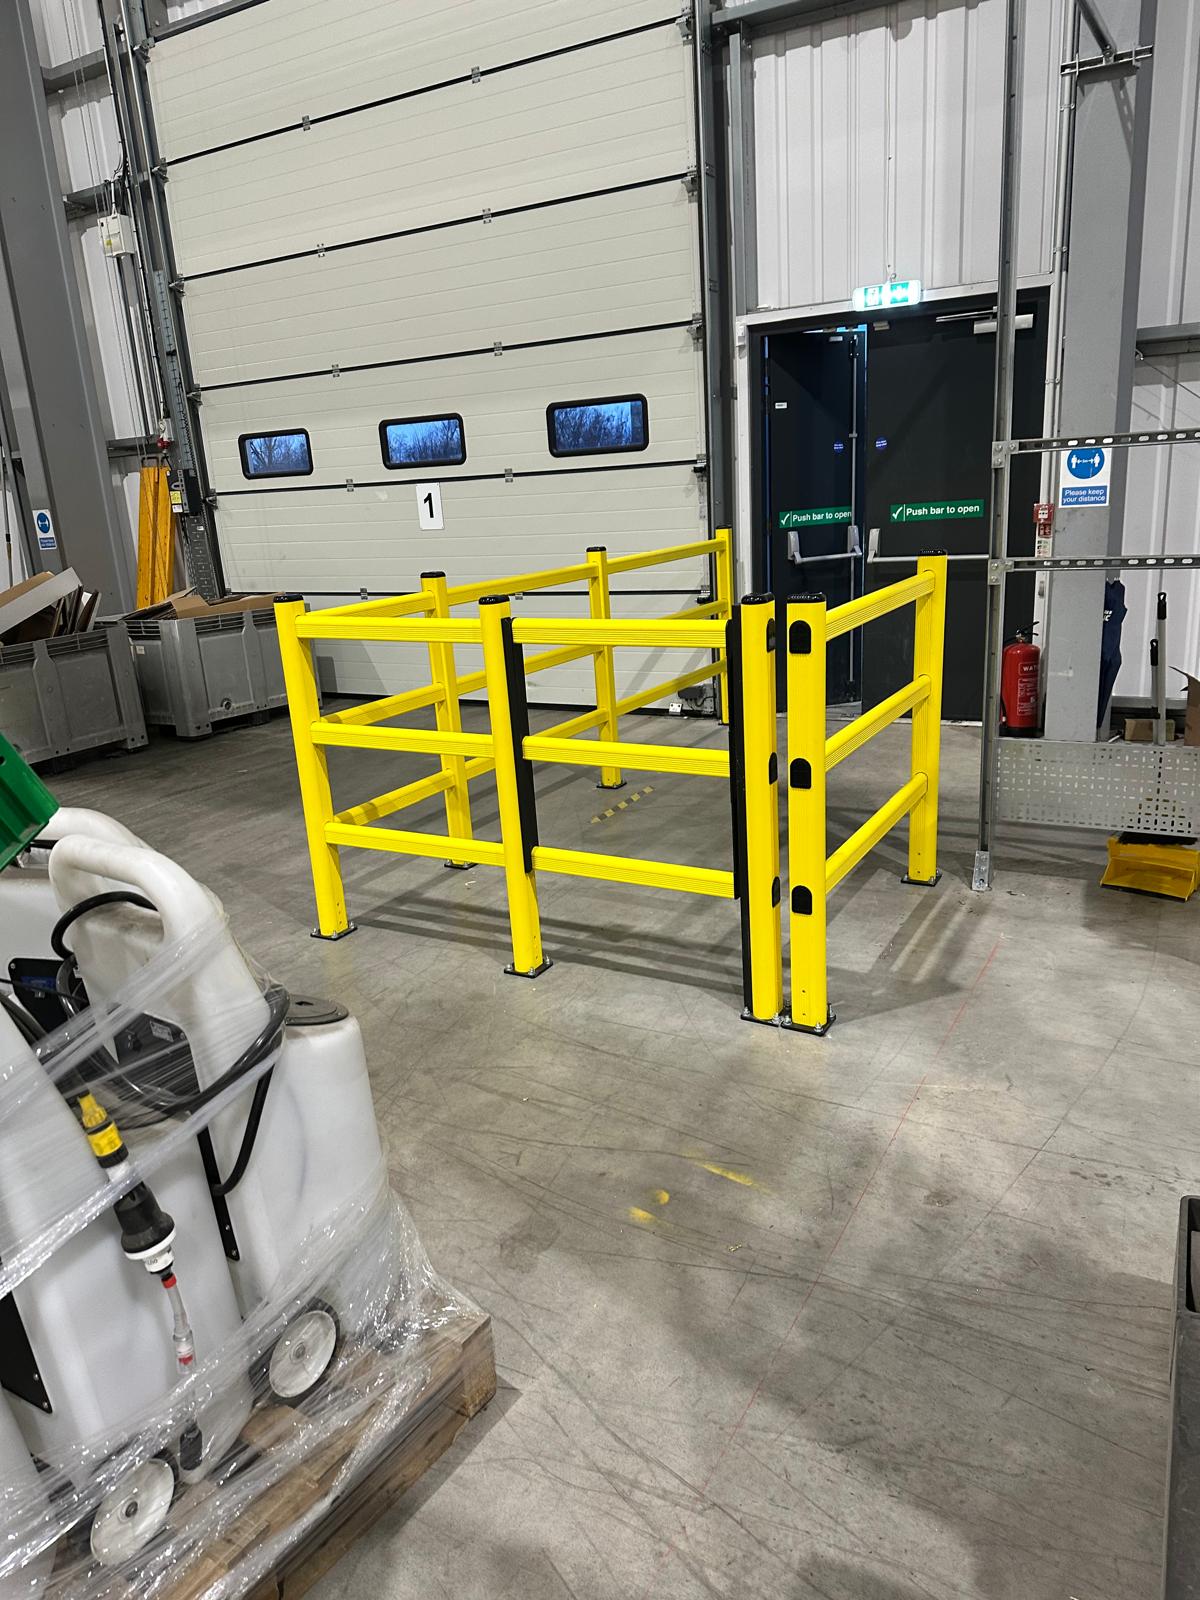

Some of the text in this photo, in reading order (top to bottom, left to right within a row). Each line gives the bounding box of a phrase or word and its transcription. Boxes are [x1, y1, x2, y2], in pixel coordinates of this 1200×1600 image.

[423, 492, 434, 518] 1
[1063, 496, 1077, 504] your
[906, 505, 980, 516] Push bar to open
[792, 511, 852, 522] Push bar to open
